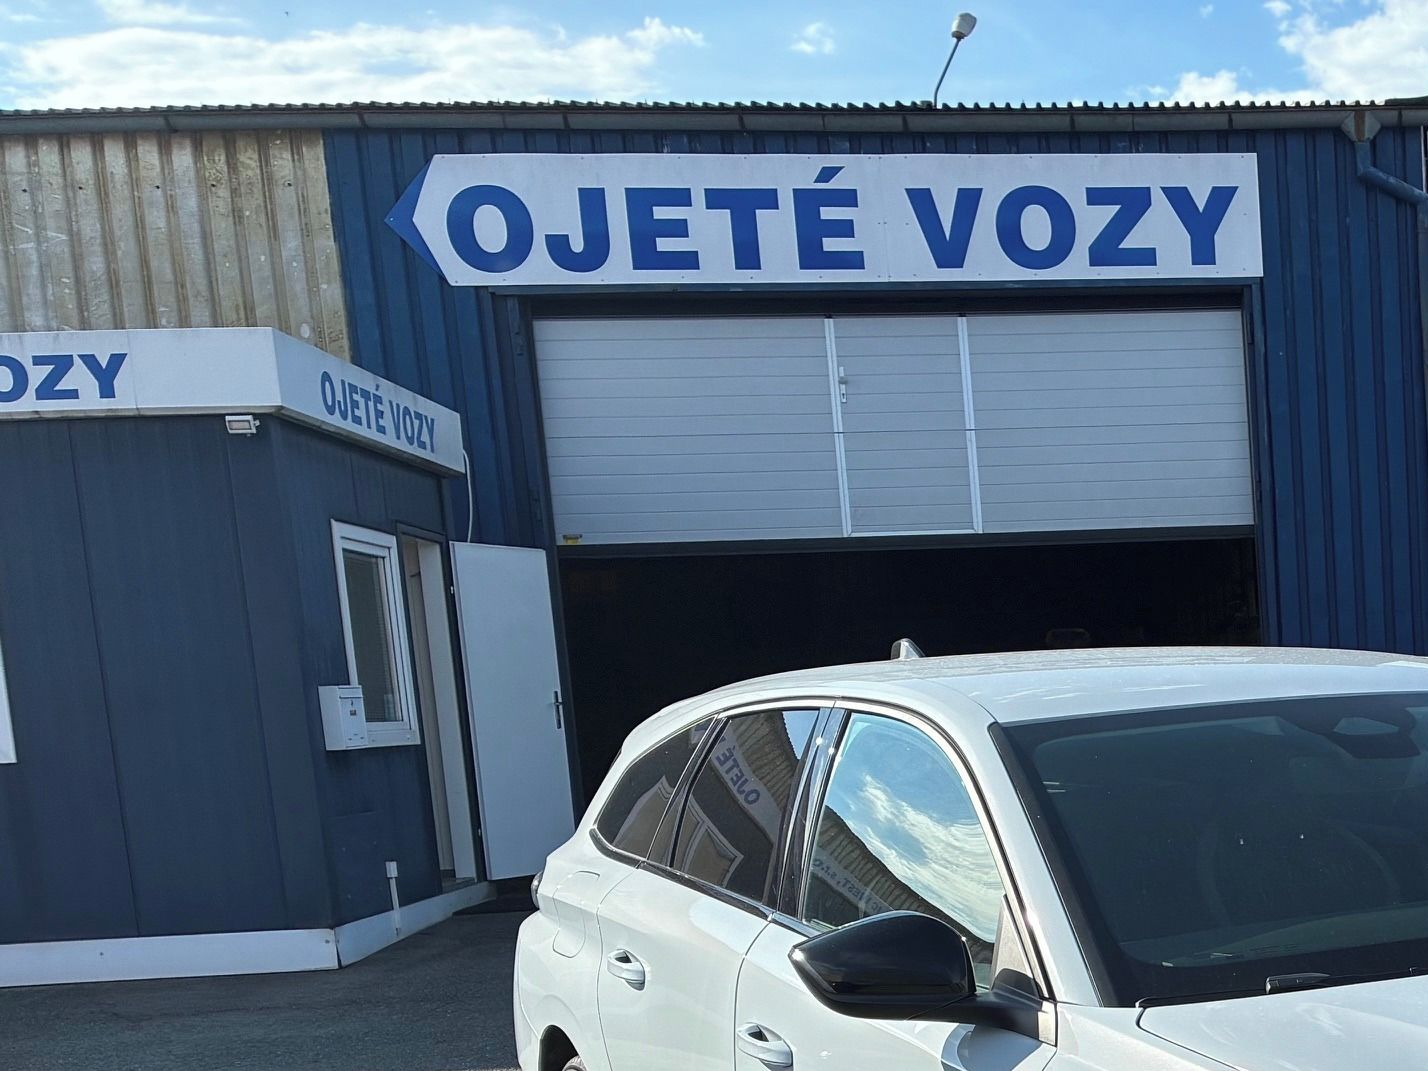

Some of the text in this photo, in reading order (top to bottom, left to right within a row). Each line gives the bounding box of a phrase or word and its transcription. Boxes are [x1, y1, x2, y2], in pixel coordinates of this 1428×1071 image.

[445, 165, 1240, 273] OJETÉ VOZY
[320, 370, 435, 454] OJETÉ VOZY
